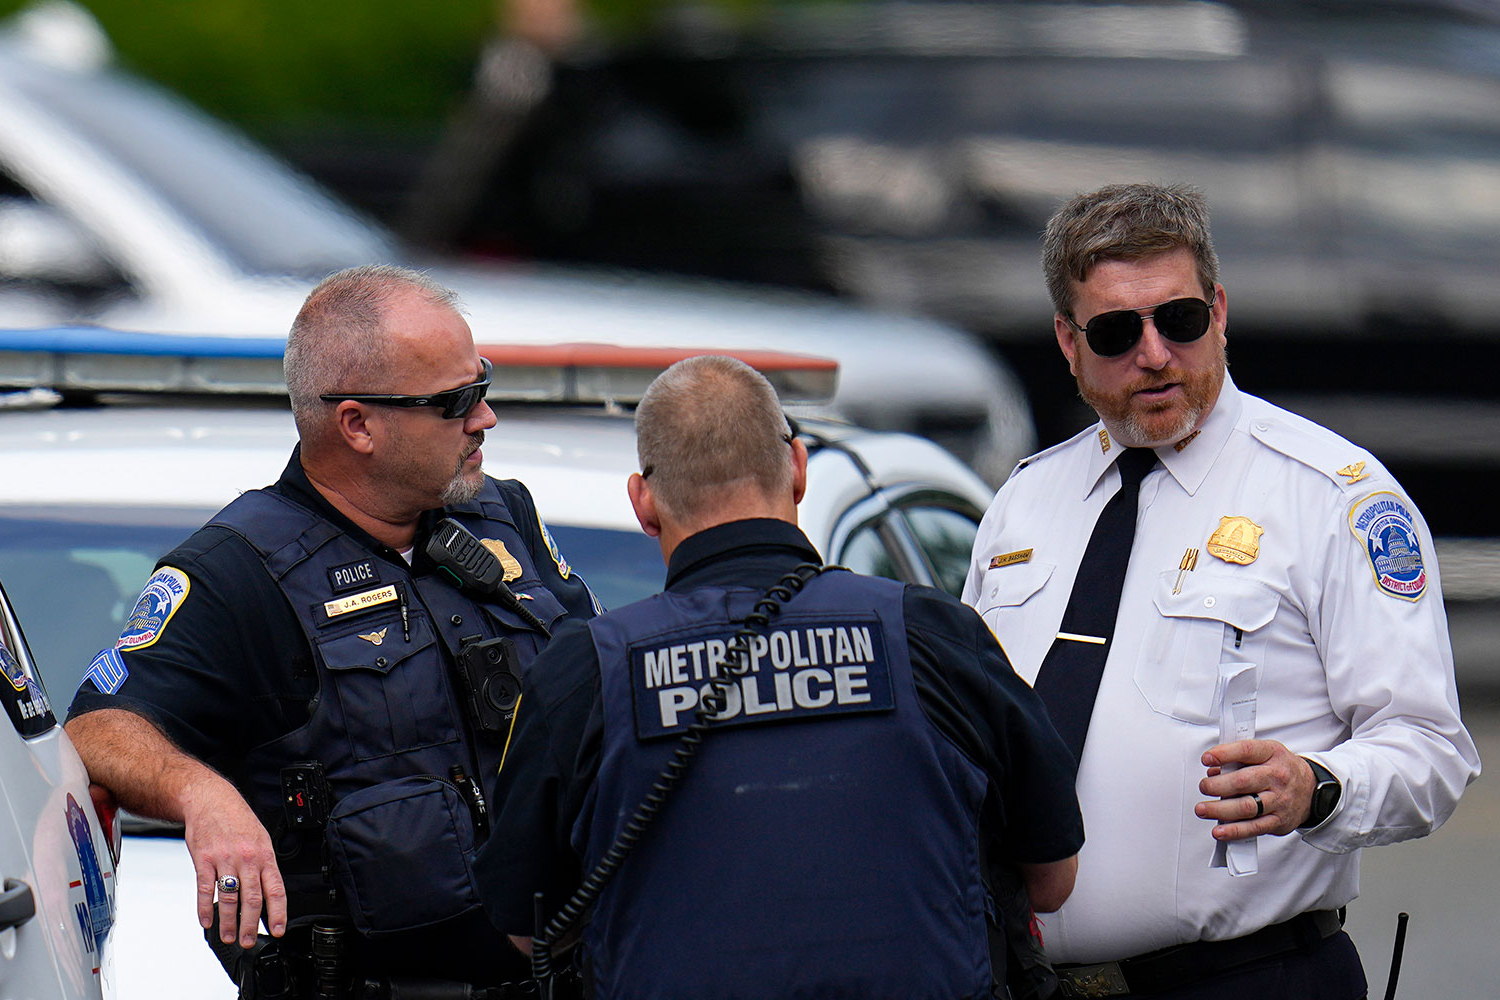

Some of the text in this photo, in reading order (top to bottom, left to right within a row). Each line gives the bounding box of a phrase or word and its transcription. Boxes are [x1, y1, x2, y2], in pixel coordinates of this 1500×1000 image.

[1355, 501, 1396, 531] METROPOLITAN
[334, 563, 373, 585] POLICE
[344, 590, 393, 609] J.A. ROGERS
[644, 626, 875, 689] METROPOLITAN
[658, 665, 871, 727] POLICE
